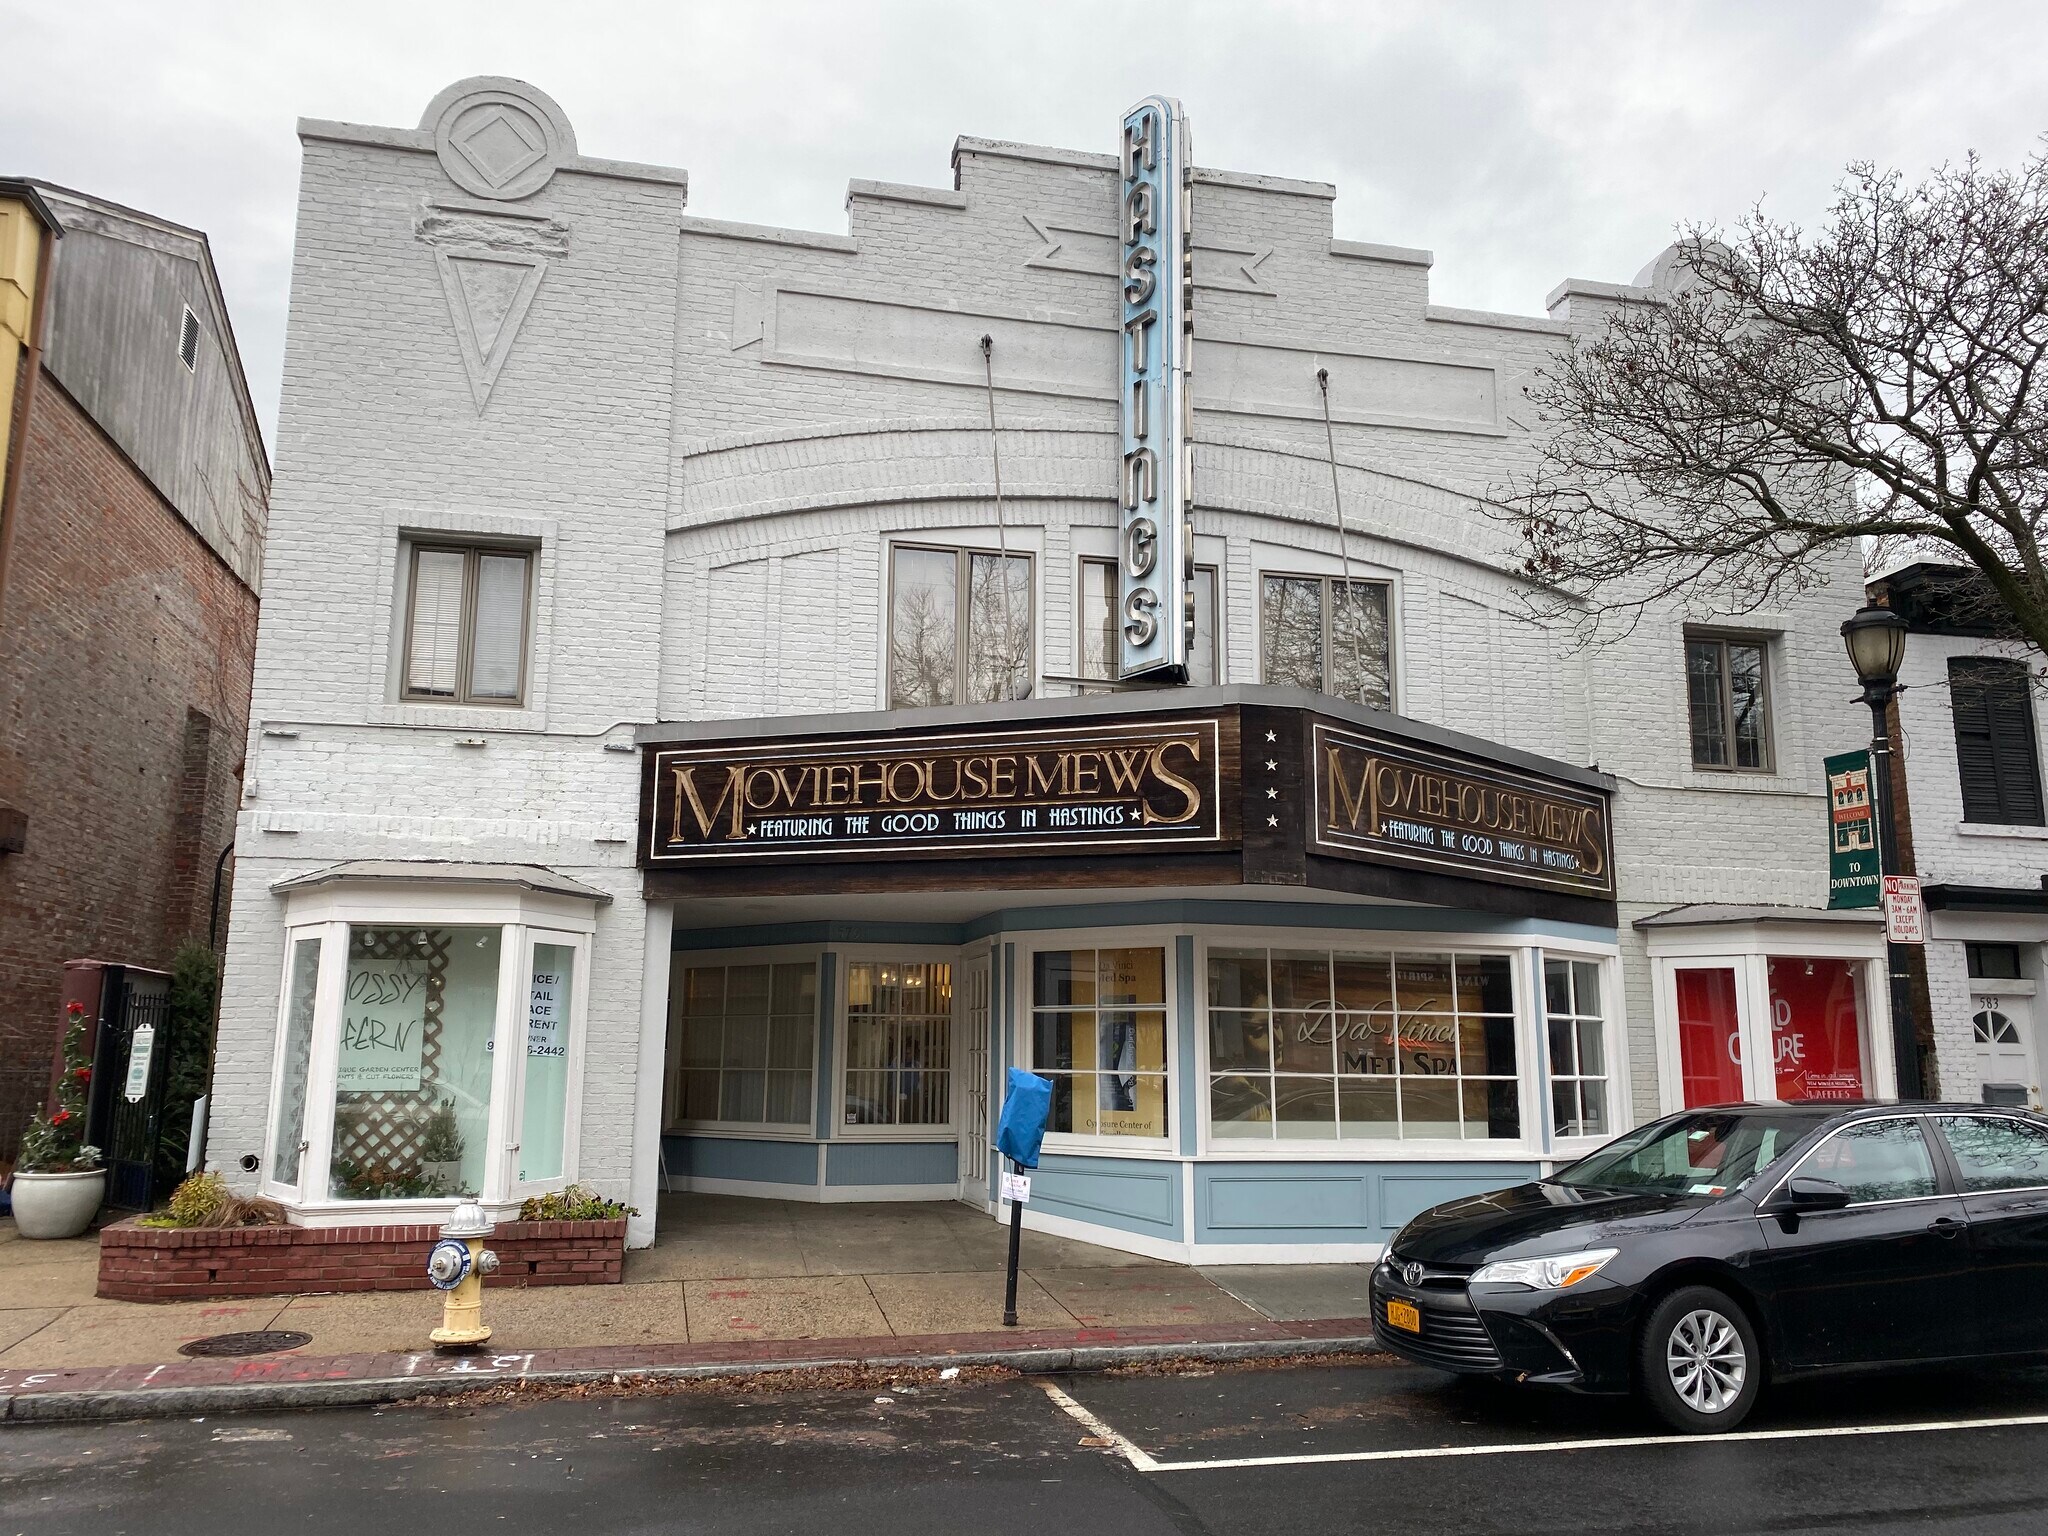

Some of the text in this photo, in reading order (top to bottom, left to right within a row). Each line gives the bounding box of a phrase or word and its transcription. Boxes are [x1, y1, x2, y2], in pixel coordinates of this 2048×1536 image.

[1123, 110, 1158, 648] HASTINGS
[668, 740, 1201, 843] MOVIEHOUSE MEWS
[1325, 746, 1604, 875] MOVIEHOUSE MEWS
[1838, 810, 1865, 820] WELCOME
[759, 805, 1124, 838] FEATURING THE GOOD THINGS IN HASTINGS
[1388, 820, 1575, 871] FEATURING THE GOOD THINGS IN HASTINGS
[1849, 862, 1861, 873] TO
[1831, 874, 1879, 889] DOWNTOWN
[1885, 879, 1918, 893] NO PARKING
[1893, 895, 1913, 904] MONDAY
[1891, 905, 1902, 914] 3AM
[1906, 905, 1918, 914] 6AM
[1895, 915, 1914, 924] EXCEPT
[1893, 925, 1919, 935] HOLIDAYS
[533, 974, 553, 985] ICE
[1118, 973, 1136, 984] Spa
[344, 970, 424, 1005] OSSY
[530, 991, 554, 1001] TAIL
[1980, 997, 1999, 1010] 583
[529, 1004, 552, 1016] ACE
[1770, 998, 1792, 1032] LD
[1298, 999, 1371, 1043] Da
[340, 1016, 417, 1052] FERN
[1809, 1090, 1850, 1099] WAFFLES
[1119, 1120, 1143, 1130] Center
[1144, 1120, 1152, 1130] of
